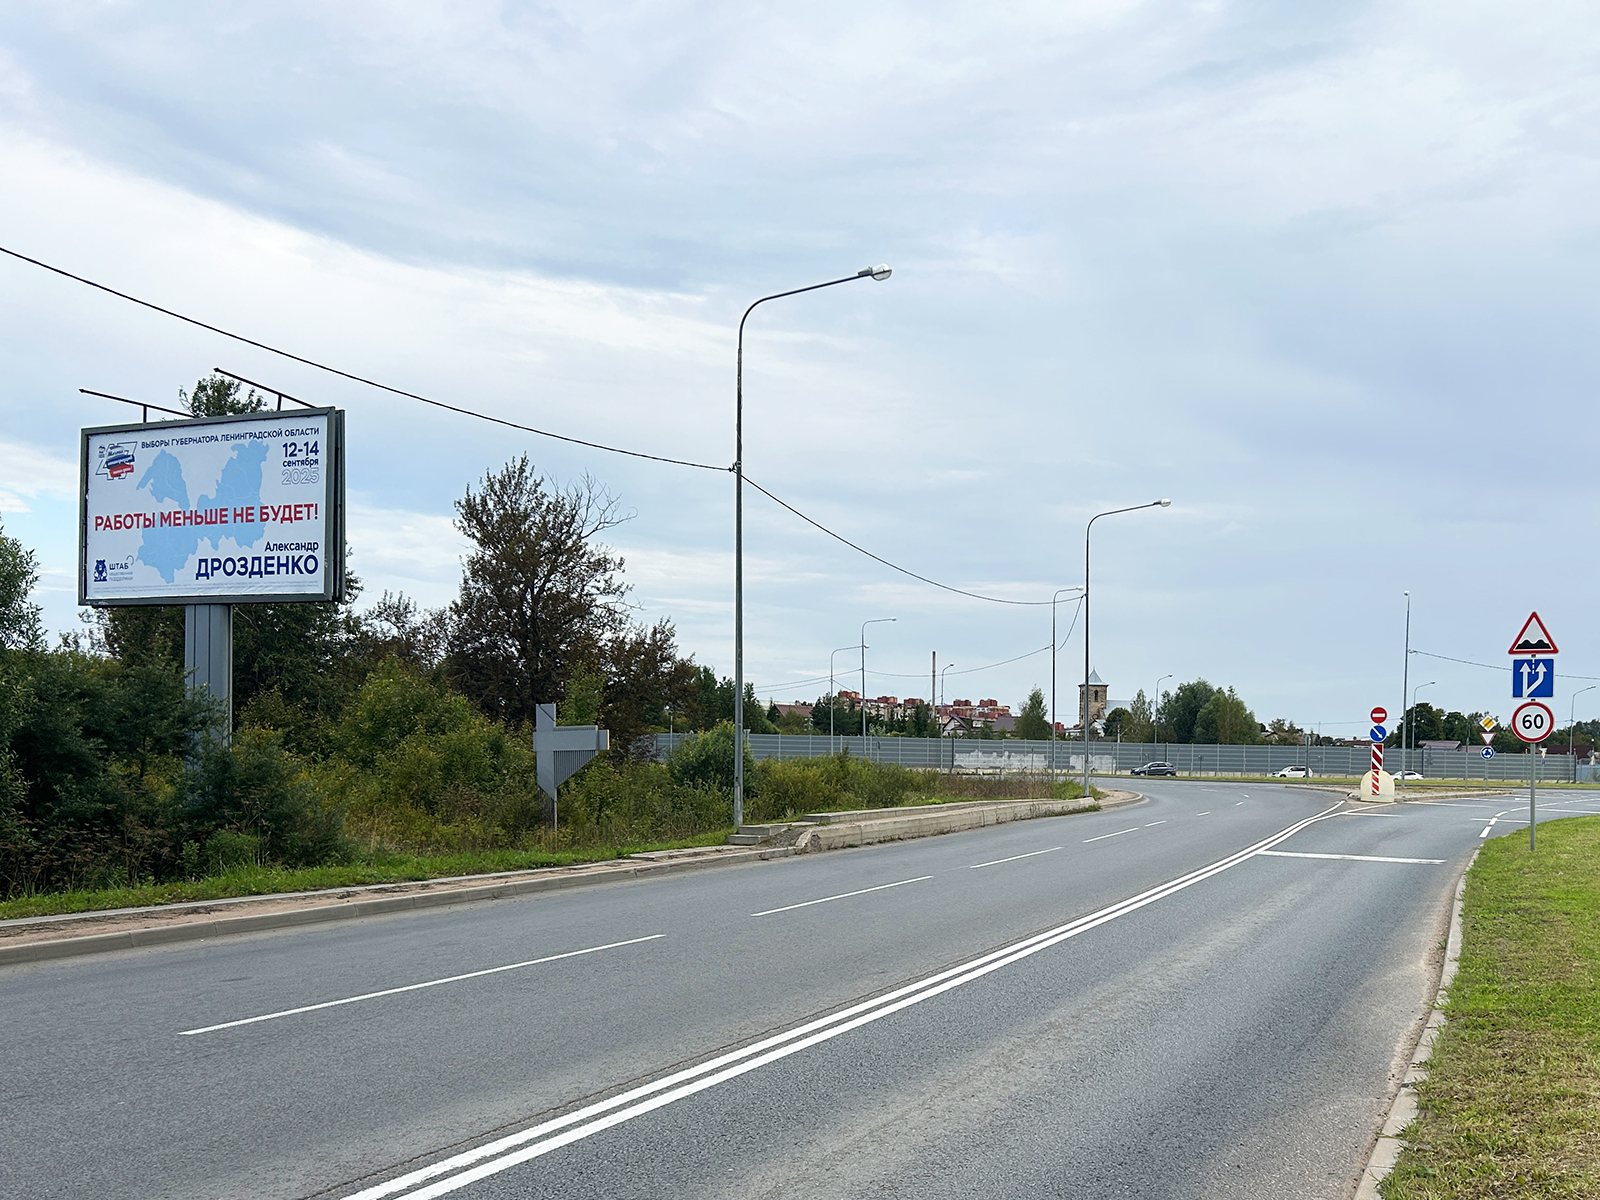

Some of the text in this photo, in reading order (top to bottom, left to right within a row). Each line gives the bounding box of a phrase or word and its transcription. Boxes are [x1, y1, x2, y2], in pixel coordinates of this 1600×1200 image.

[141, 427, 320, 449] ВЫБОРЫ ГУБЕРНАТОРА ЛЕНИНГРАДСКОЙ ОБЛАСТИ
[282, 440, 319, 458] 12-14
[282, 457, 319, 468] сентября
[281, 467, 319, 485] 2025
[94, 503, 319, 531] РАБОТЫ МЕНЬШЕ НЕ БУДЕТ!
[264, 541, 319, 553] Александр
[108, 562, 129, 571] ШТАБ
[195, 554, 319, 580] ДРОЗДЕНКО
[1522, 713, 1544, 730] 60
